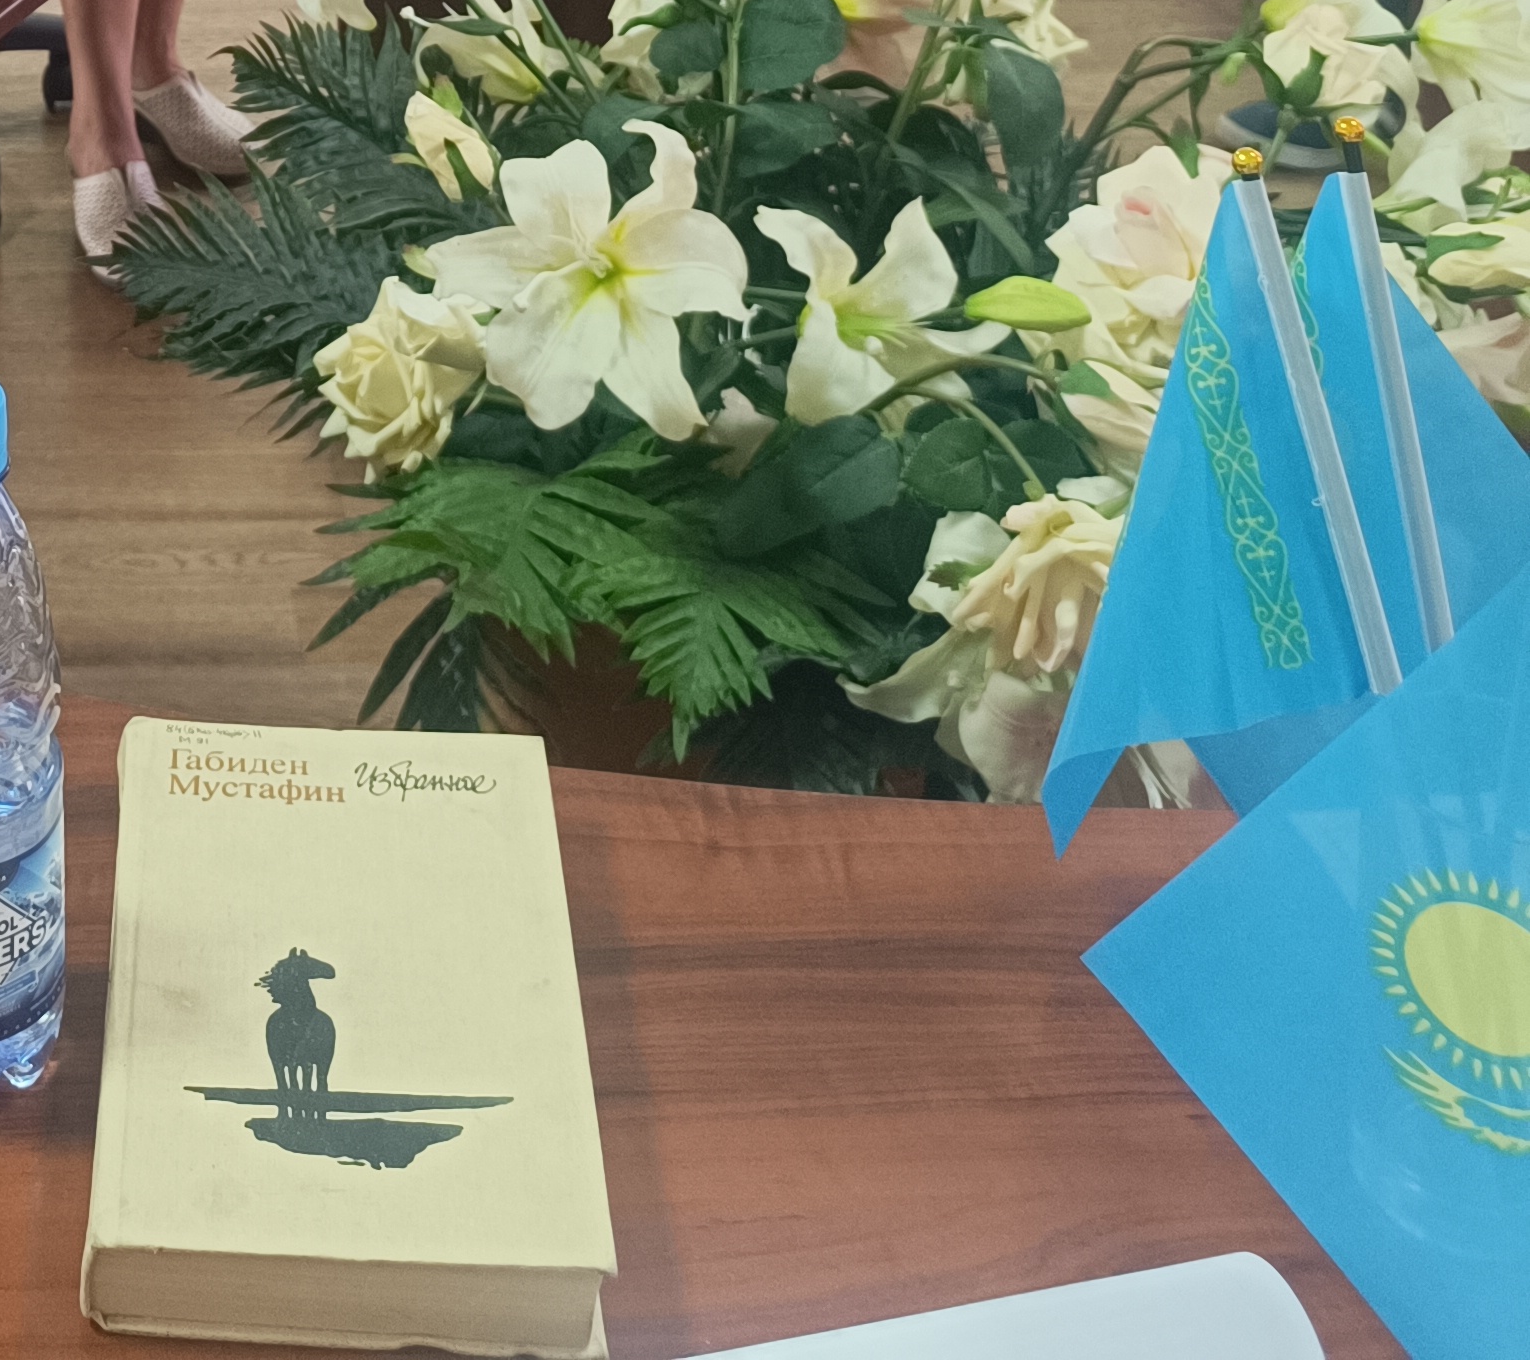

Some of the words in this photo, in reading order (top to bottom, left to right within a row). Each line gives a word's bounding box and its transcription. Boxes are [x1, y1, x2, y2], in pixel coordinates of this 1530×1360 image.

[168, 748, 310, 776] Габиден
[168, 773, 346, 804] Мустафин
[354, 760, 497, 802] Избранное
